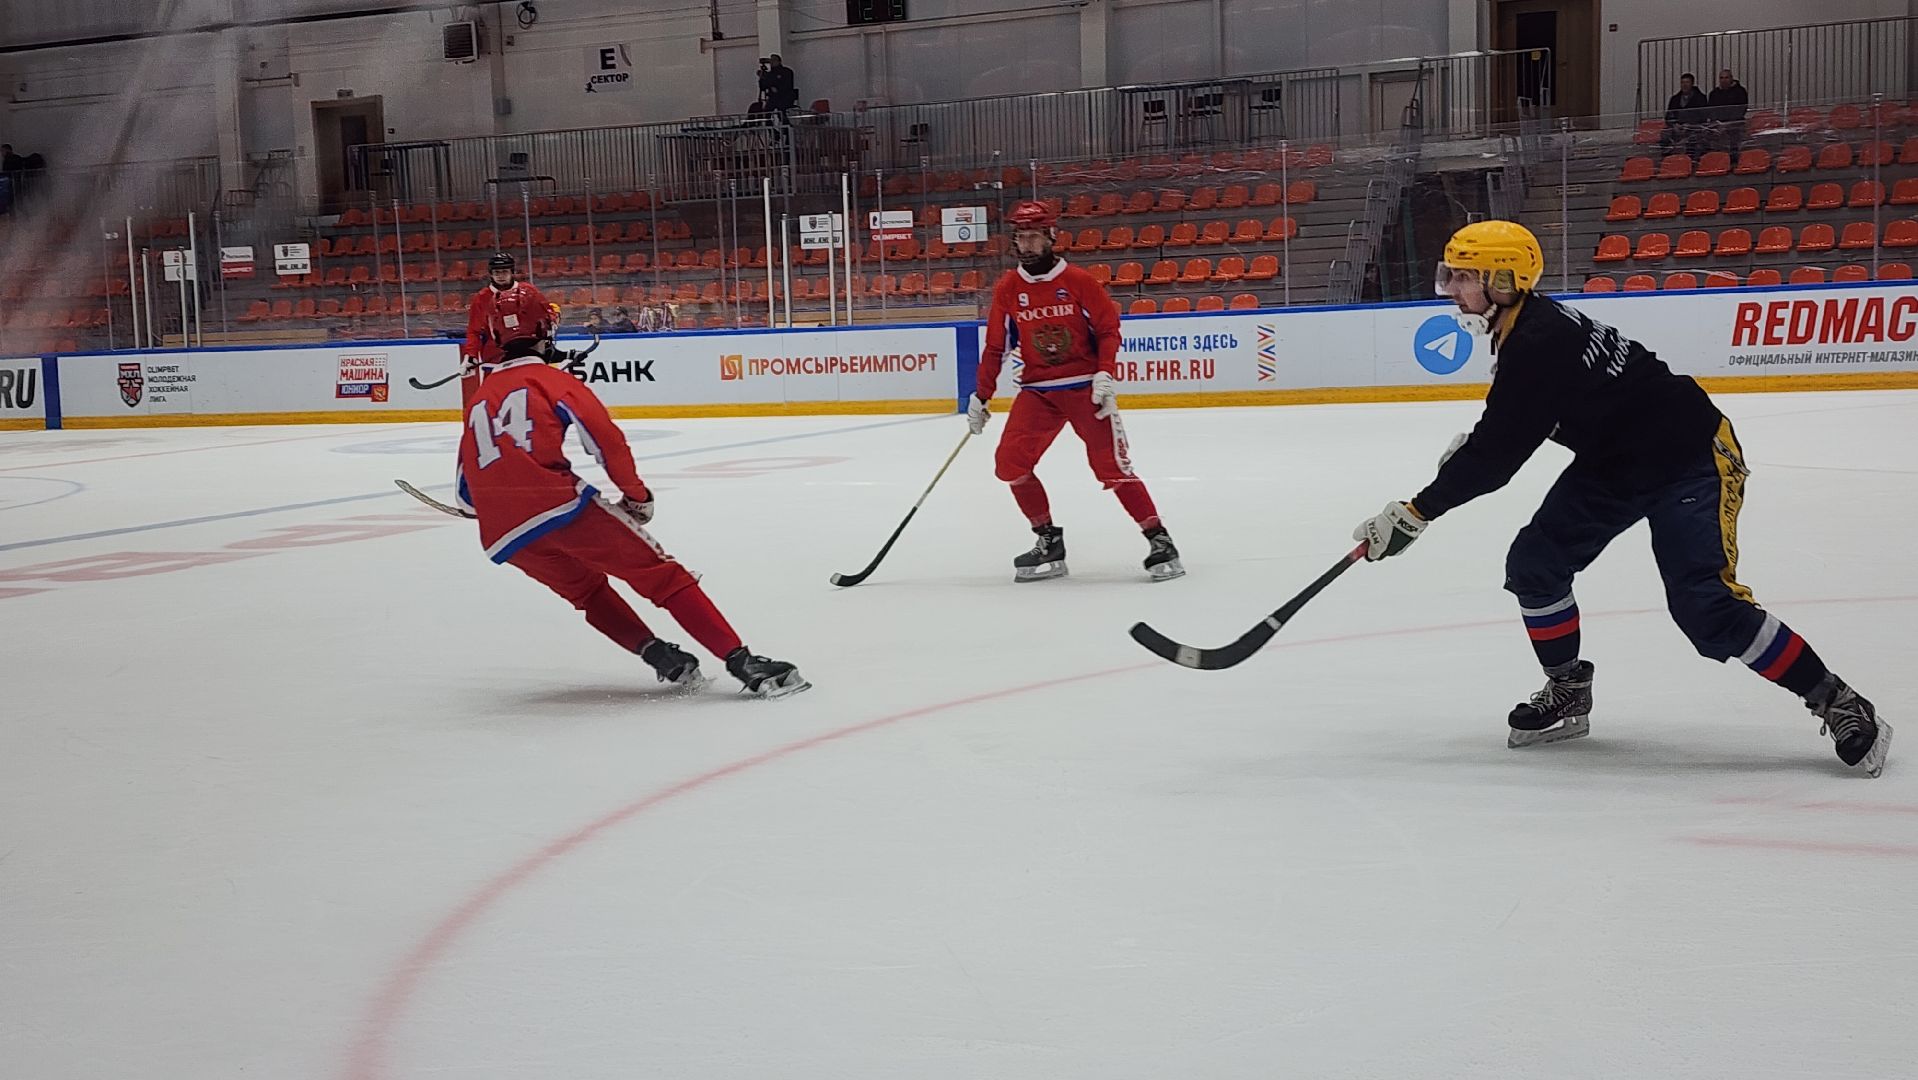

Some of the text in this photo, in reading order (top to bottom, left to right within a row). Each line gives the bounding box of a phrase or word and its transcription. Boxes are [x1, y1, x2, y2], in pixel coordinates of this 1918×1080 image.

[591, 73, 629, 84] СЕКТОР
[1018, 292, 1030, 307] 9
[1016, 303, 1074, 323] РОССИЯ
[1731, 296, 1918, 347] REDMAC
[1193, 334, 1238, 352] ЗДЕСЬ
[340, 357, 375, 367] КРАСНАЯ
[748, 353, 938, 376] ПРОМСЫРЬЕИМПОРТ
[1728, 350, 1812, 367] ОФИЦИАЛЬНЫЙ
[148, 375, 196, 383] МОЛОДЕЖНАЯ
[340, 367, 385, 381] МАШИНА
[148, 384, 189, 393] ХОККЕЙНАЯ
[468, 387, 534, 470] 14
